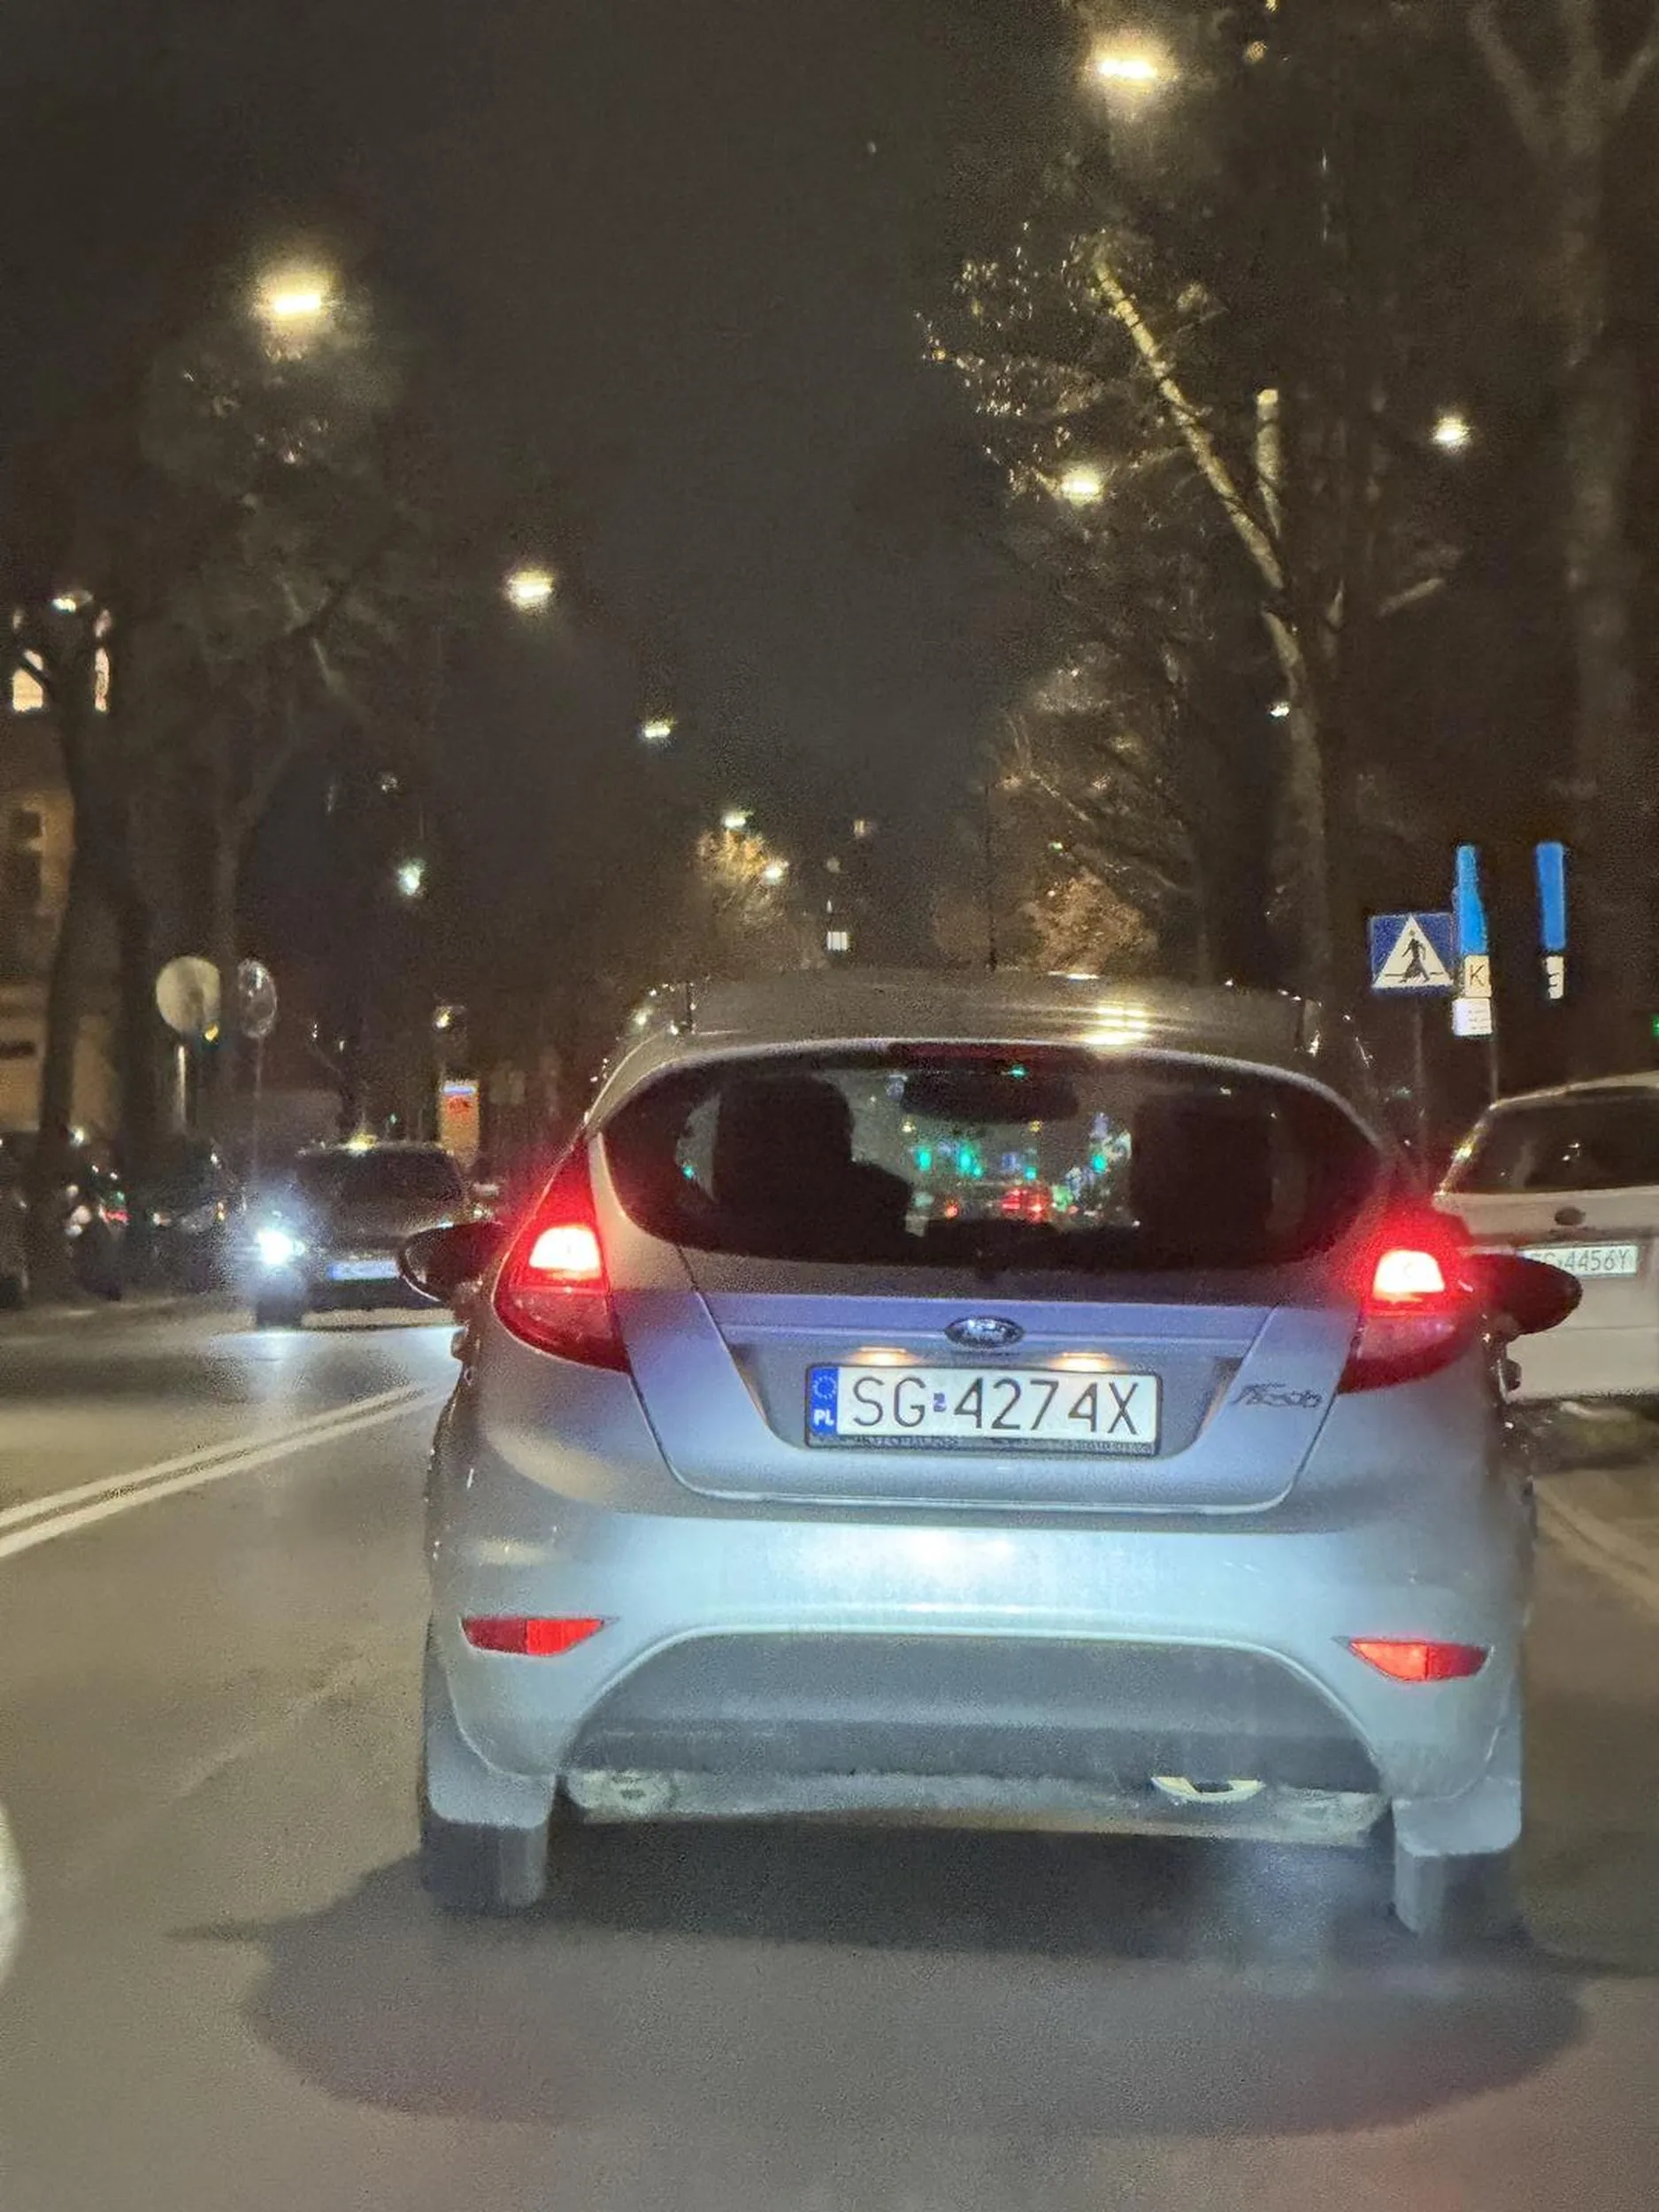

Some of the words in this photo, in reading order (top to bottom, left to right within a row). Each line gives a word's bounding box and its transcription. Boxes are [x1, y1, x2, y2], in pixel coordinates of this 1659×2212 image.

[813, 1408, 834, 1426] PL
[852, 1376, 926, 1428] SG
[954, 1377, 1139, 1435] 4274X
